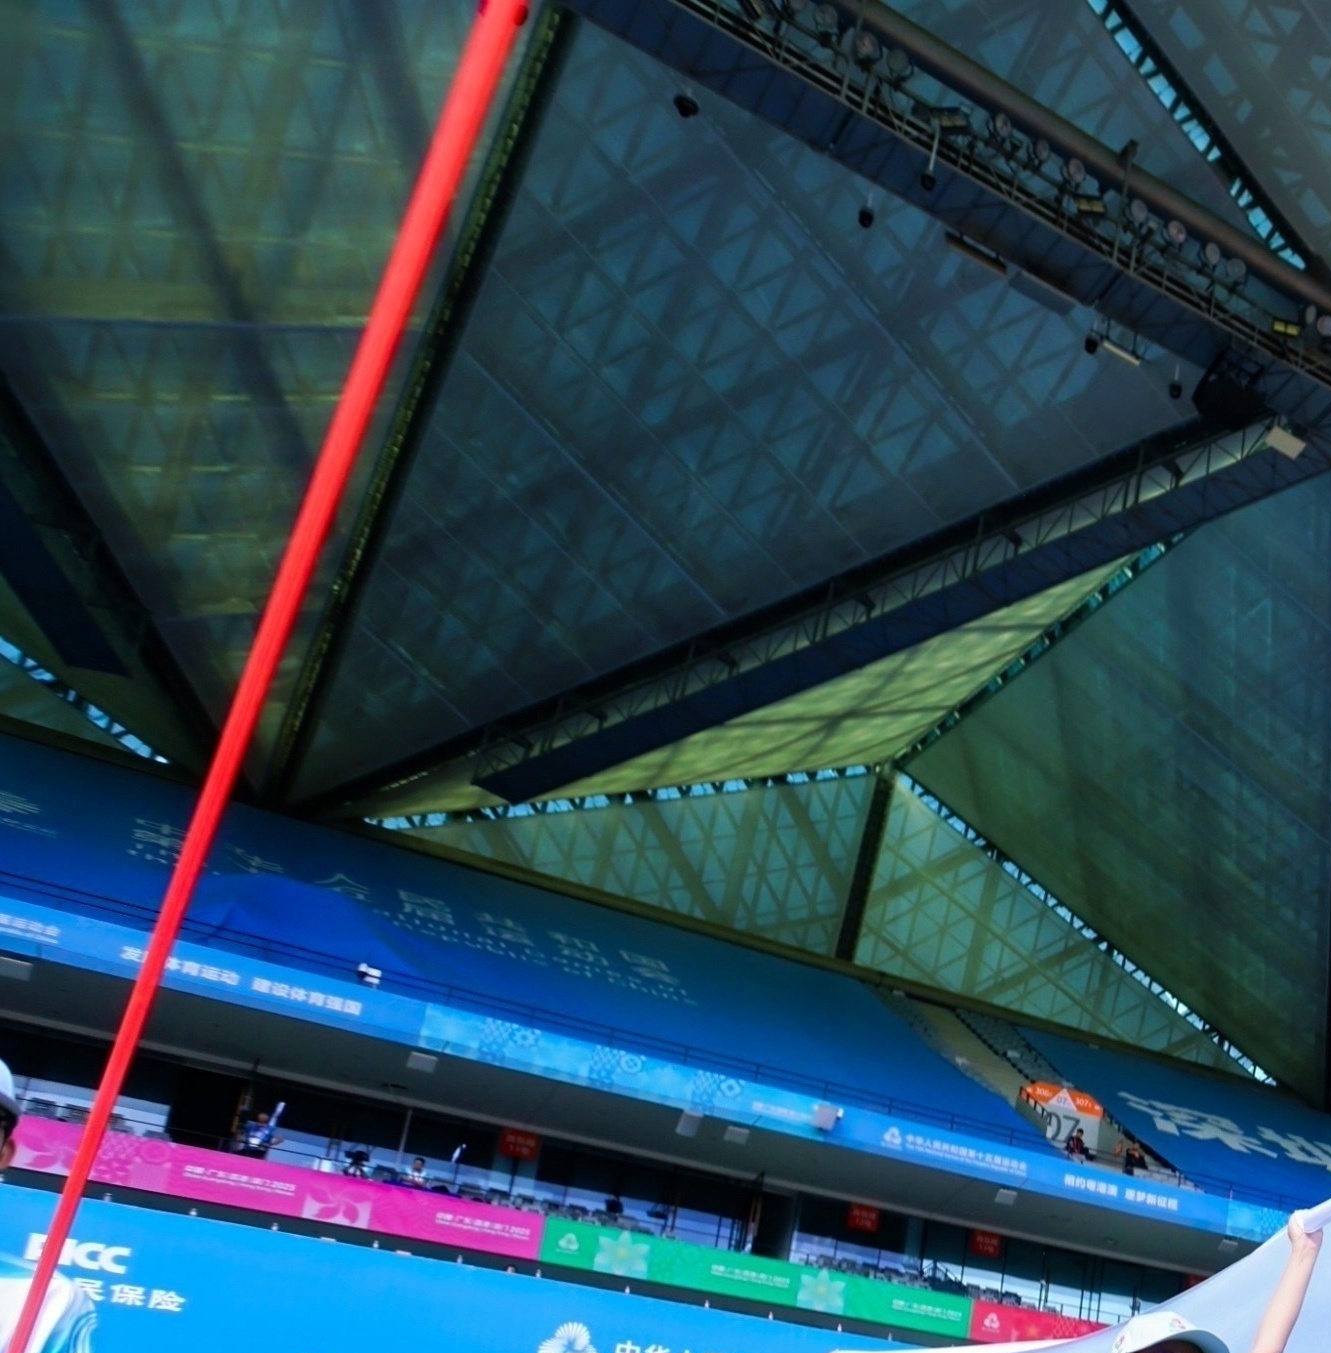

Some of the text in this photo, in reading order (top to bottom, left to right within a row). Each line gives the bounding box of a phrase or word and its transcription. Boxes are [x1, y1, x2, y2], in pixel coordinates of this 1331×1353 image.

[120, 945, 240, 986] 发体育运动
